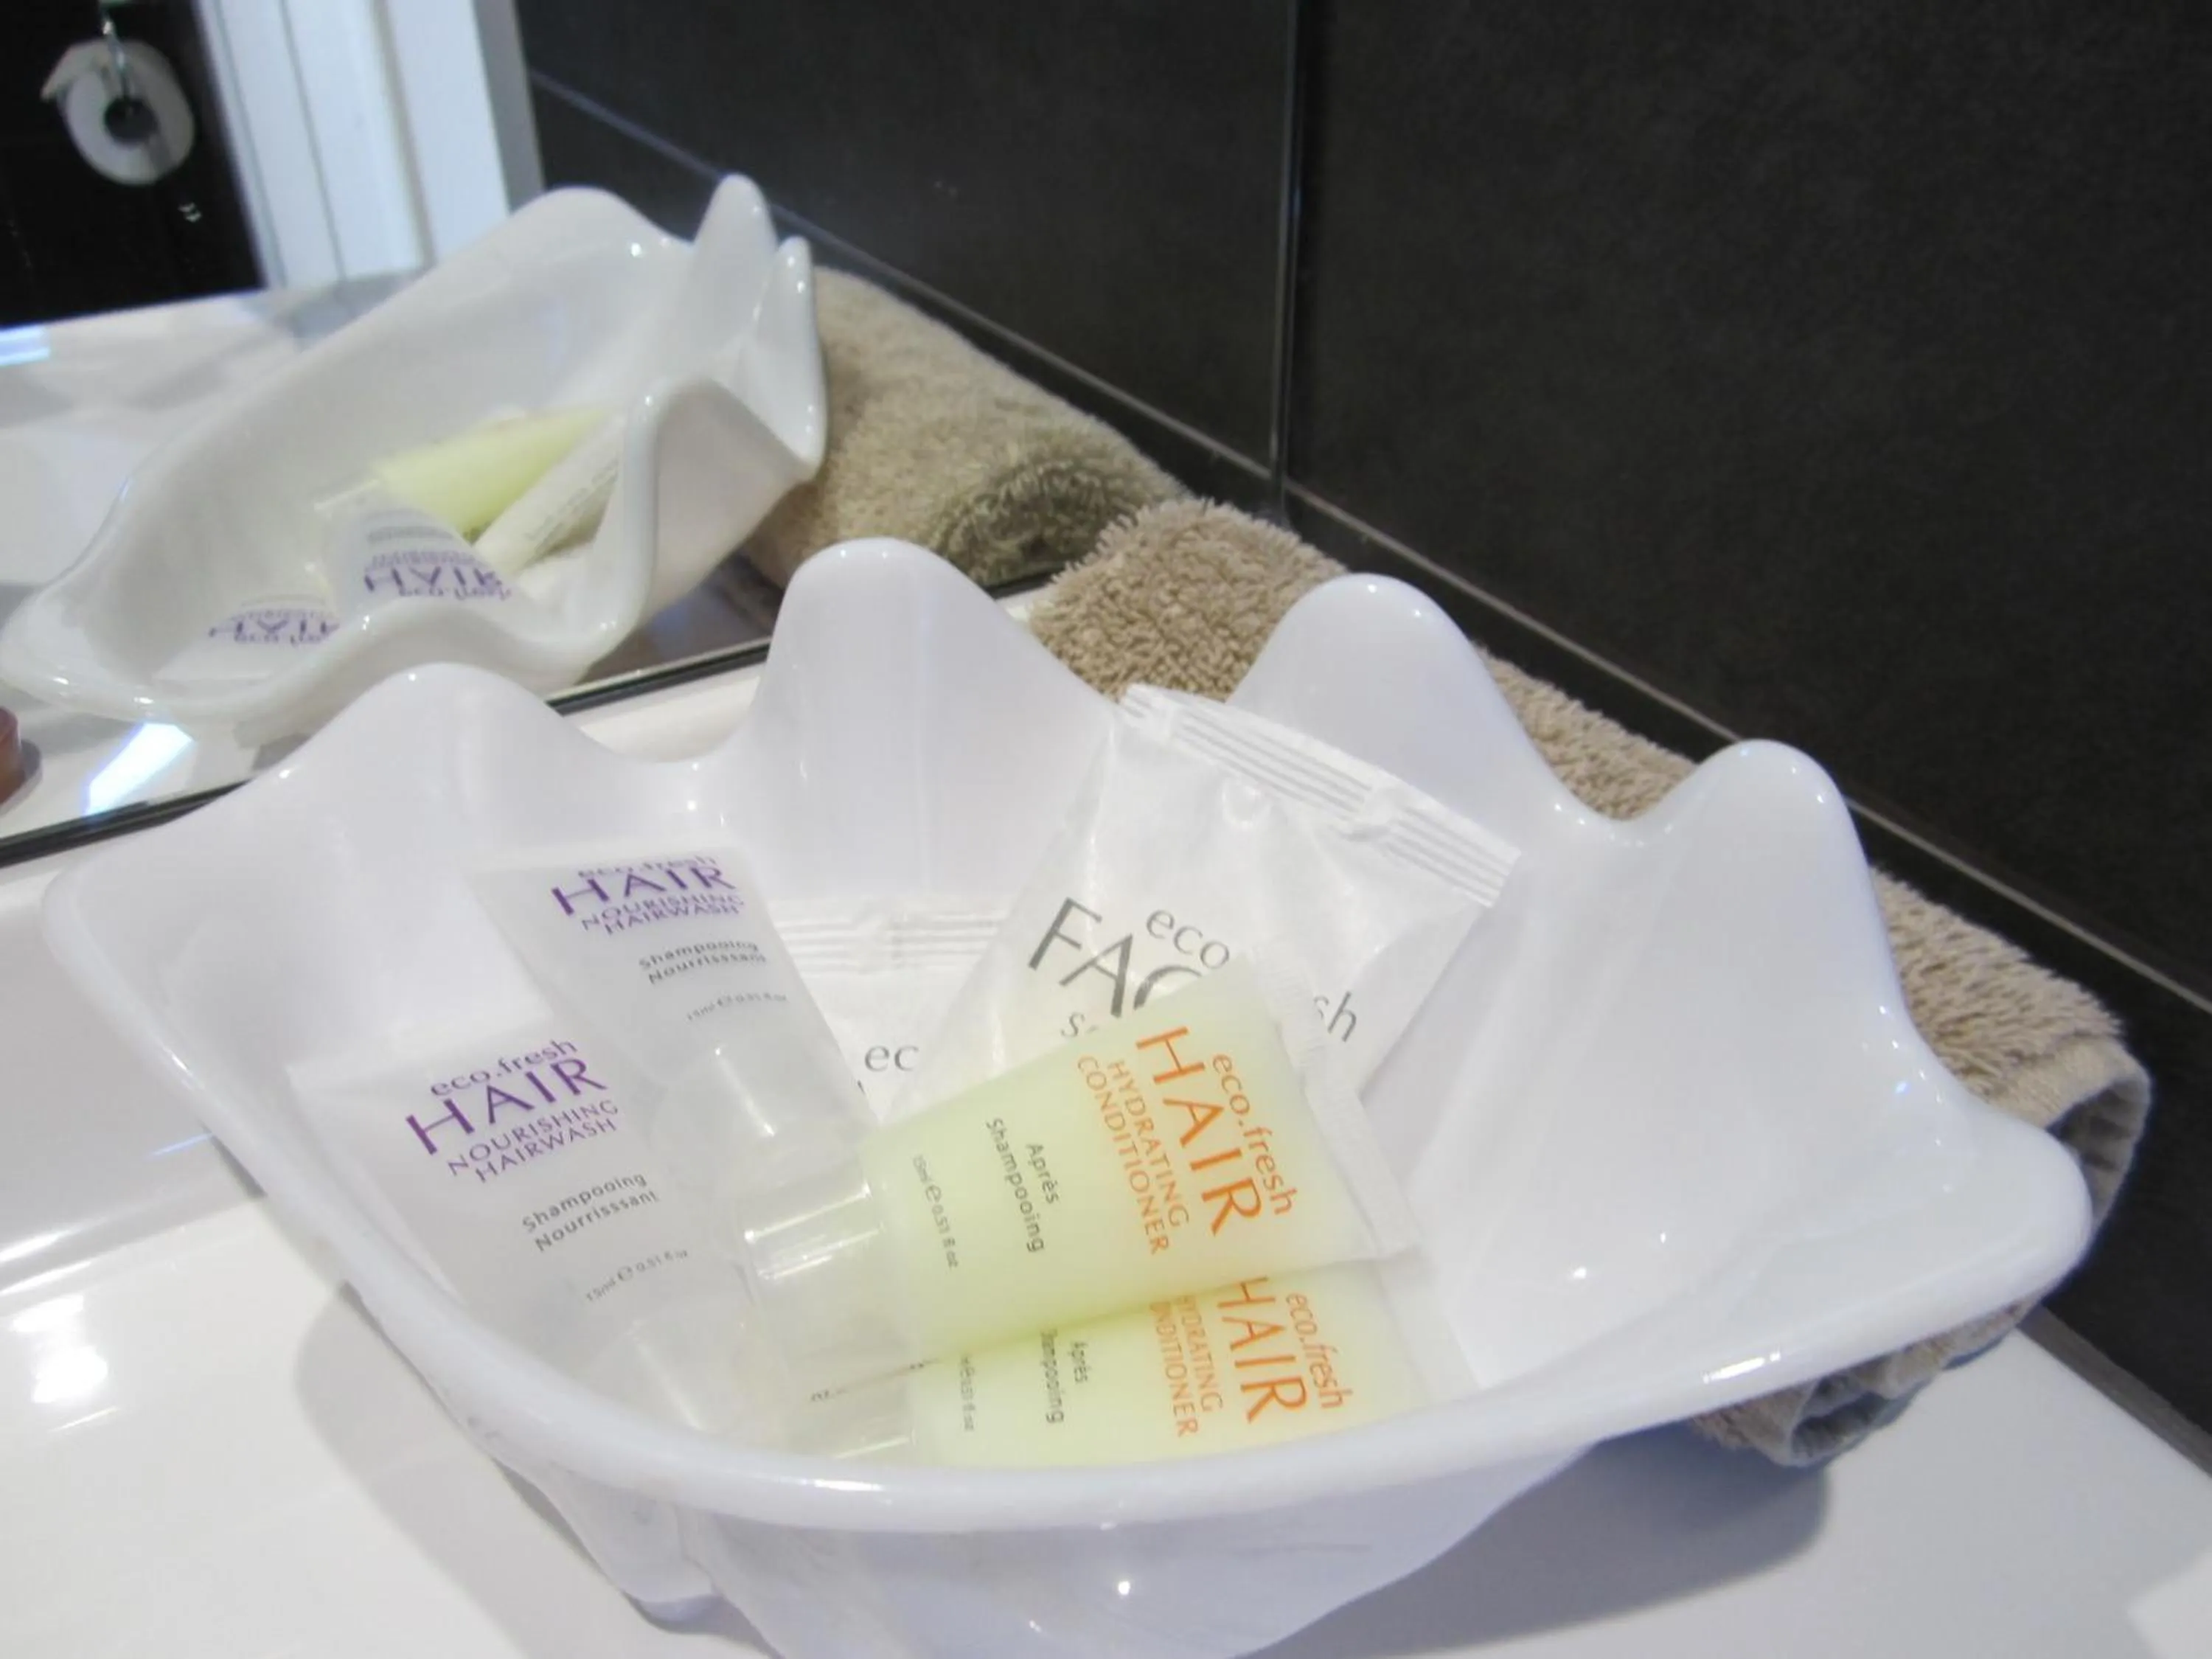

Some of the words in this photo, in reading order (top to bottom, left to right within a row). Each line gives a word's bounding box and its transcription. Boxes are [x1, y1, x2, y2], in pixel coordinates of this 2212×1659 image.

[551, 865, 737, 916] HAIR
[581, 893, 745, 931] NOURISHING
[604, 903, 740, 935] HAIRWASH
[638, 940, 759, 970] Shampooing
[405, 1057, 609, 1156] HAIR
[429, 1039, 579, 1097] eco.fresh
[447, 1099, 619, 1177] NOURISHING
[475, 1117, 618, 1184] HAIRWASH
[1077, 1054, 1169, 1256] CONDITIONER
[1107, 1059, 1190, 1228] HYDRATING
[1135, 1026, 1263, 1237] HAIR
[1211, 1053, 1298, 1216] eco.fresh
[521, 1173, 647, 1234] Shampooing
[985, 1117, 1046, 1253] Shampooing
[1217, 1275, 1307, 1424] HAIR
[1285, 1293, 1354, 1409] eco.fresh
